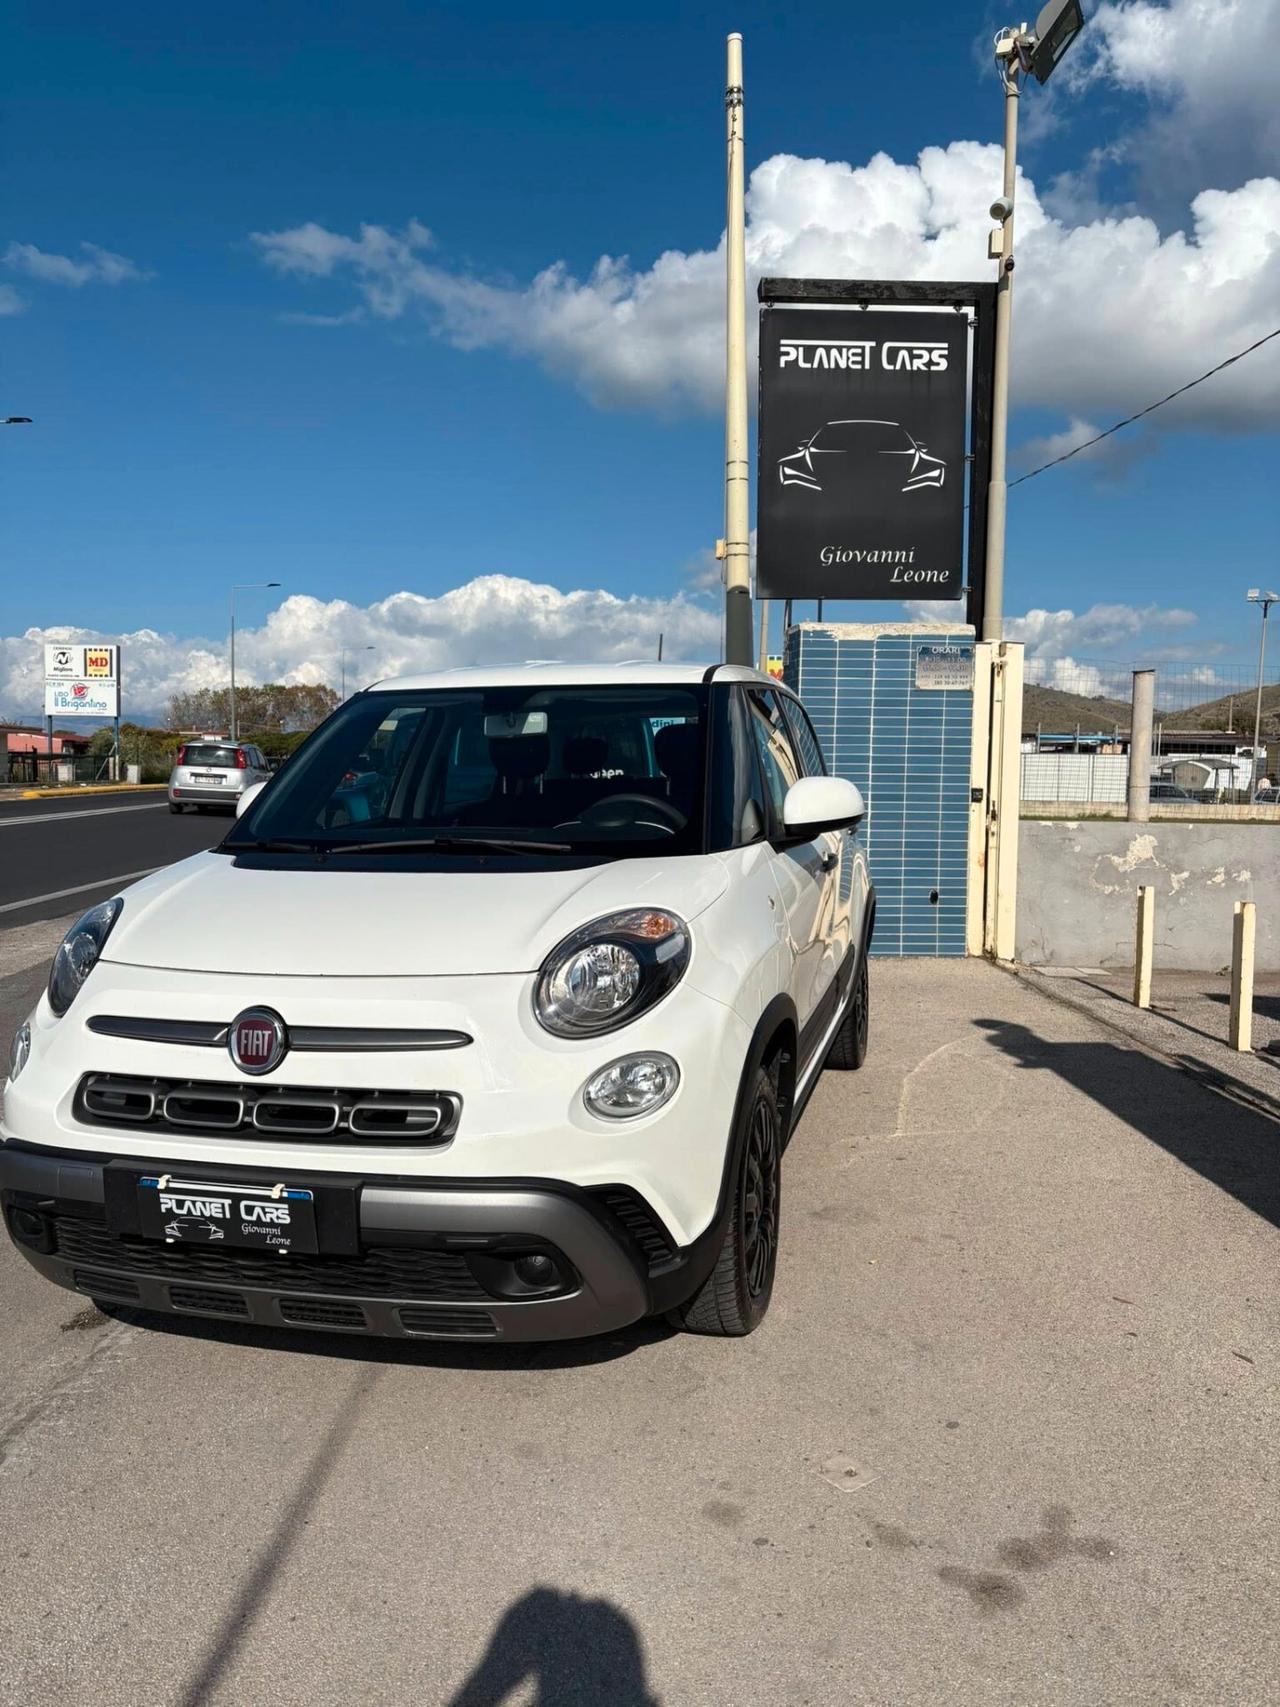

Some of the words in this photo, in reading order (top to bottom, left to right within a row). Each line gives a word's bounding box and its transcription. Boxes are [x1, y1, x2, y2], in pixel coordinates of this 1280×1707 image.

[779, 339, 876, 370] PLANET
[881, 341, 949, 371] CARS
[819, 545, 915, 567] Giovanni
[890, 565, 949, 583] Leone
[88, 657, 108, 667] MD
[61, 697, 107, 711] Brigantino
[240, 1029, 272, 1057] FIAT
[159, 1193, 232, 1219] PLANET
[240, 1200, 291, 1224] CARS
[241, 1223, 281, 1235] Giovanni
[265, 1234, 292, 1246] Leone
